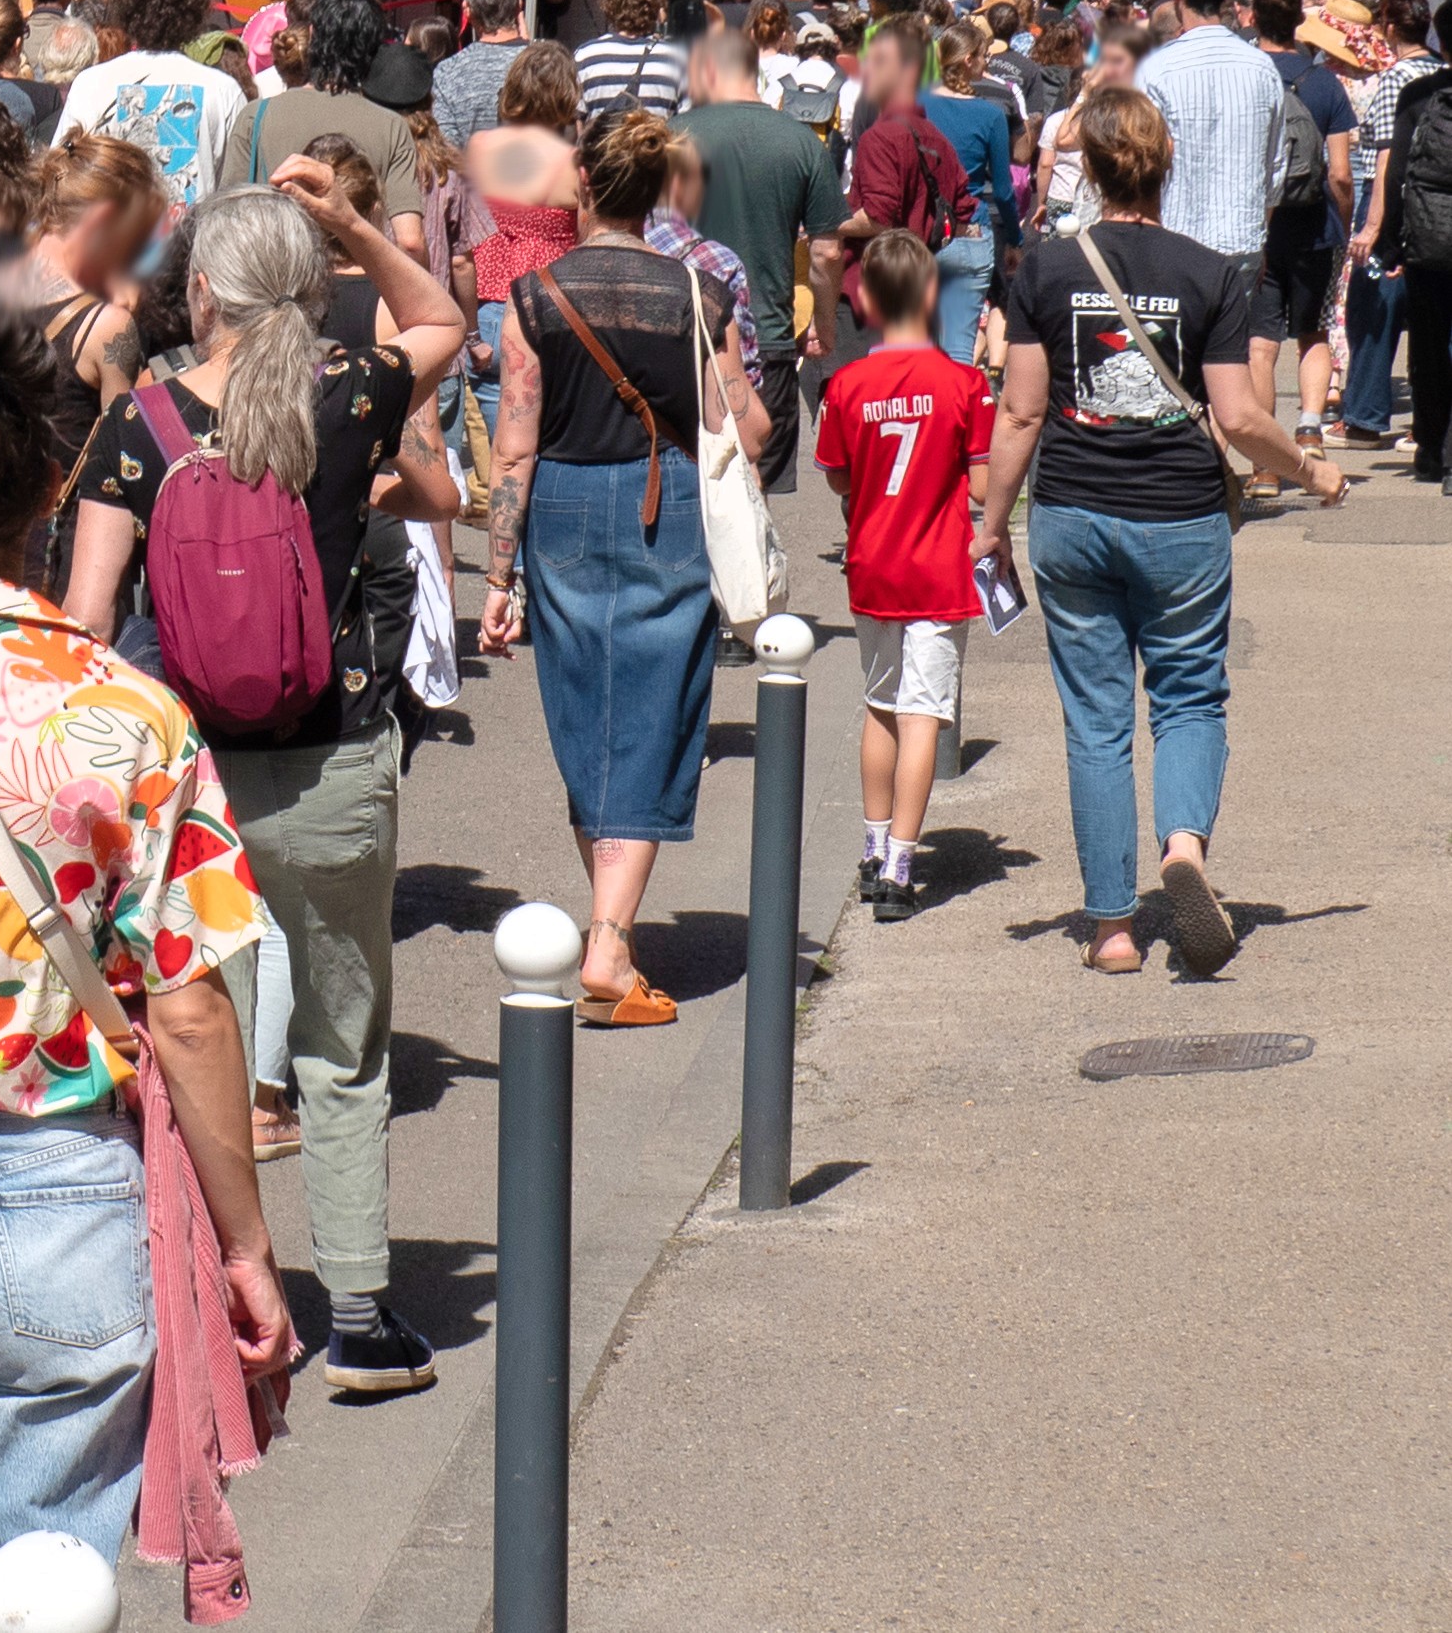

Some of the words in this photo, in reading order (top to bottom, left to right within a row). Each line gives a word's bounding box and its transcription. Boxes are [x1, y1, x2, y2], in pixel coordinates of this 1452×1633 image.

[1148, 296, 1179, 313] FEU
[862, 394, 933, 424] RONALDO
[879, 421, 921, 496] 7
